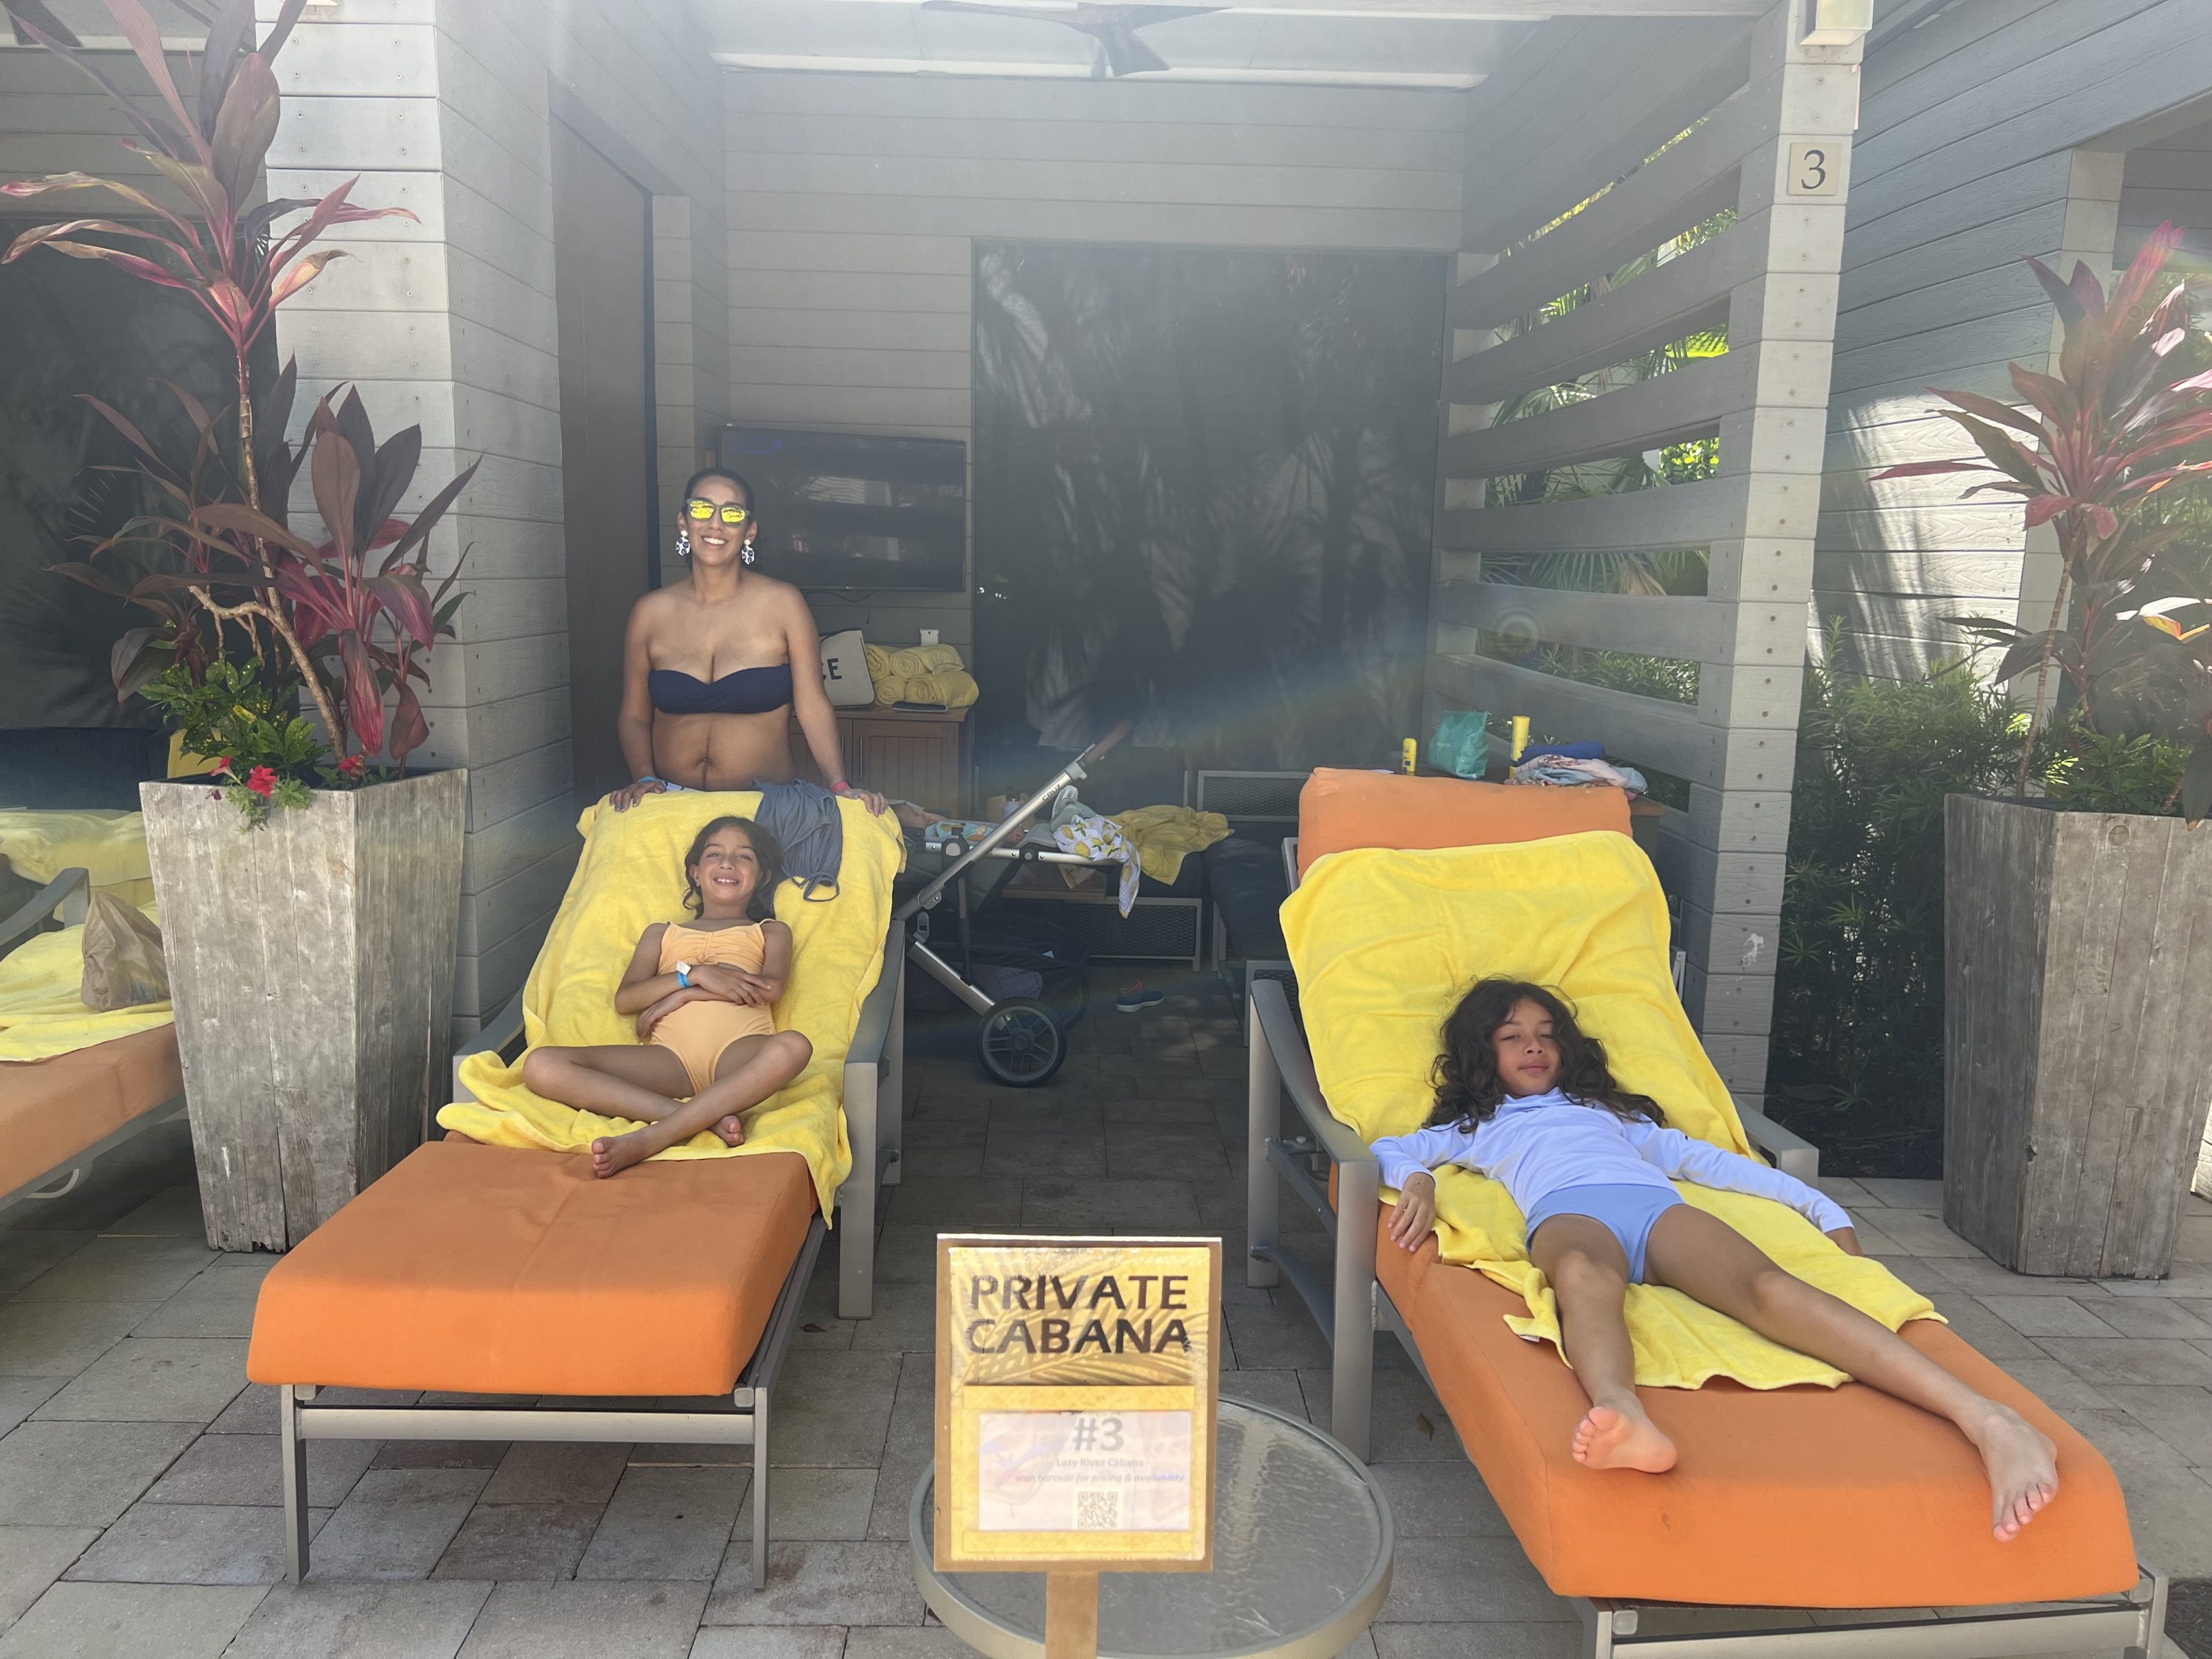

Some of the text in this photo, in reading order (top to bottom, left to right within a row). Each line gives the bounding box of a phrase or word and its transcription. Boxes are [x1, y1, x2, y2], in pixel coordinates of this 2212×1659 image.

[1801, 150, 1826, 189] 3
[1042, 784, 1061, 801] CRUZ
[970, 1275, 1189, 1310] PRIVATE
[965, 1318, 1192, 1354] CABANA
[1072, 1417, 1124, 1451] #3
[1015, 1472, 1185, 1484] scan barcode for pricing & availability
[1056, 1457, 1144, 1469] Lazy River Cabana
